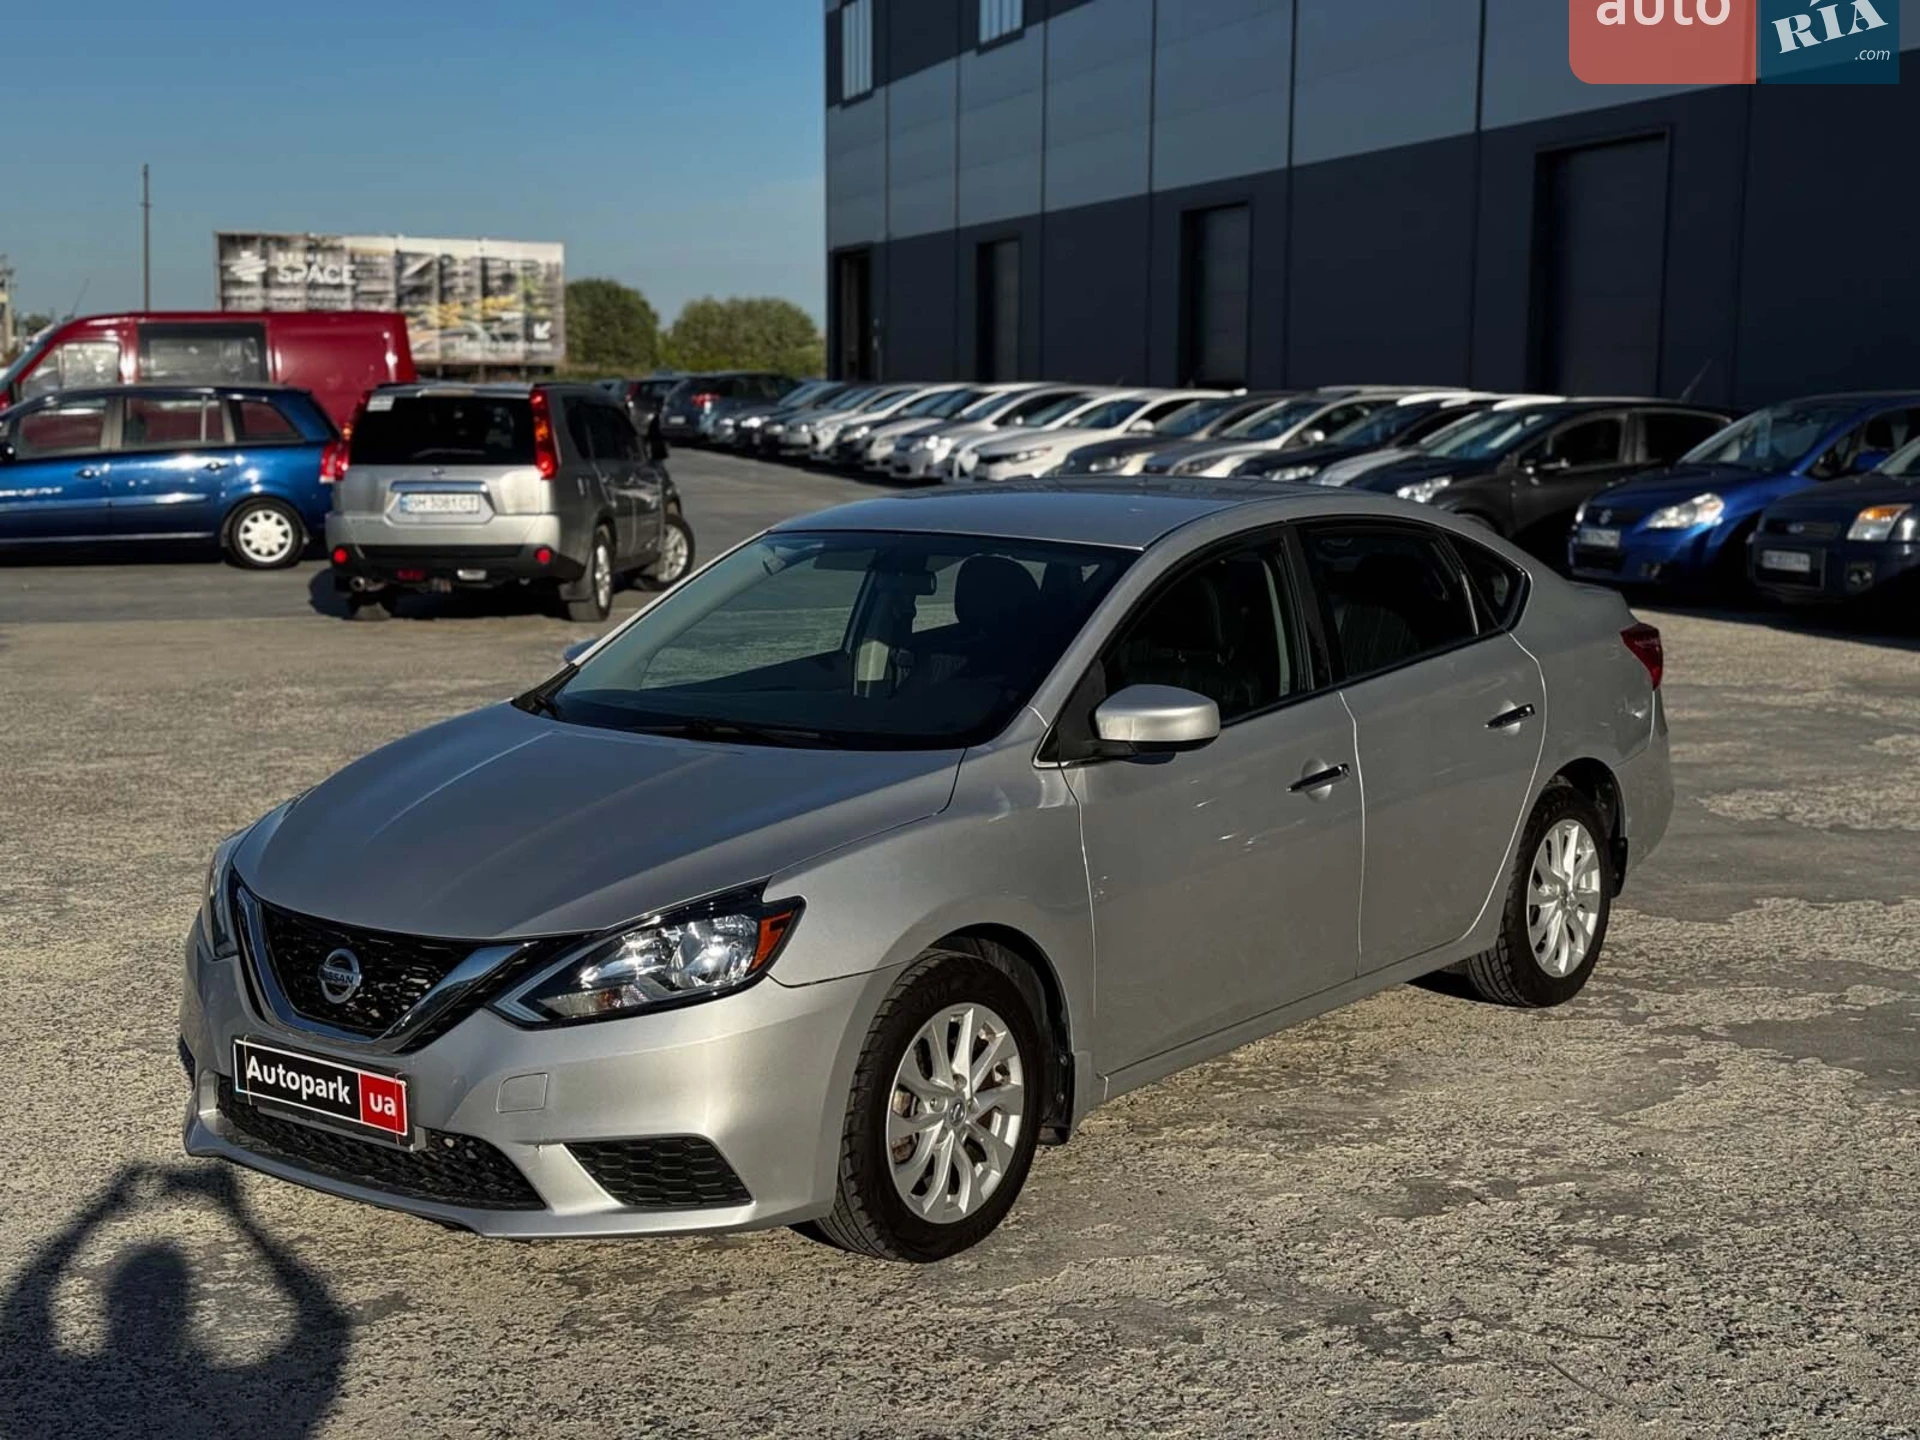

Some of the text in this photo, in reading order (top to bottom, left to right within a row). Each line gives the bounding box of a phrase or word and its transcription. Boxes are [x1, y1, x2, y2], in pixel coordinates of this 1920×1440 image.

[276, 263, 357, 286] SPACE
[247, 1056, 397, 1117] Autopark ua
